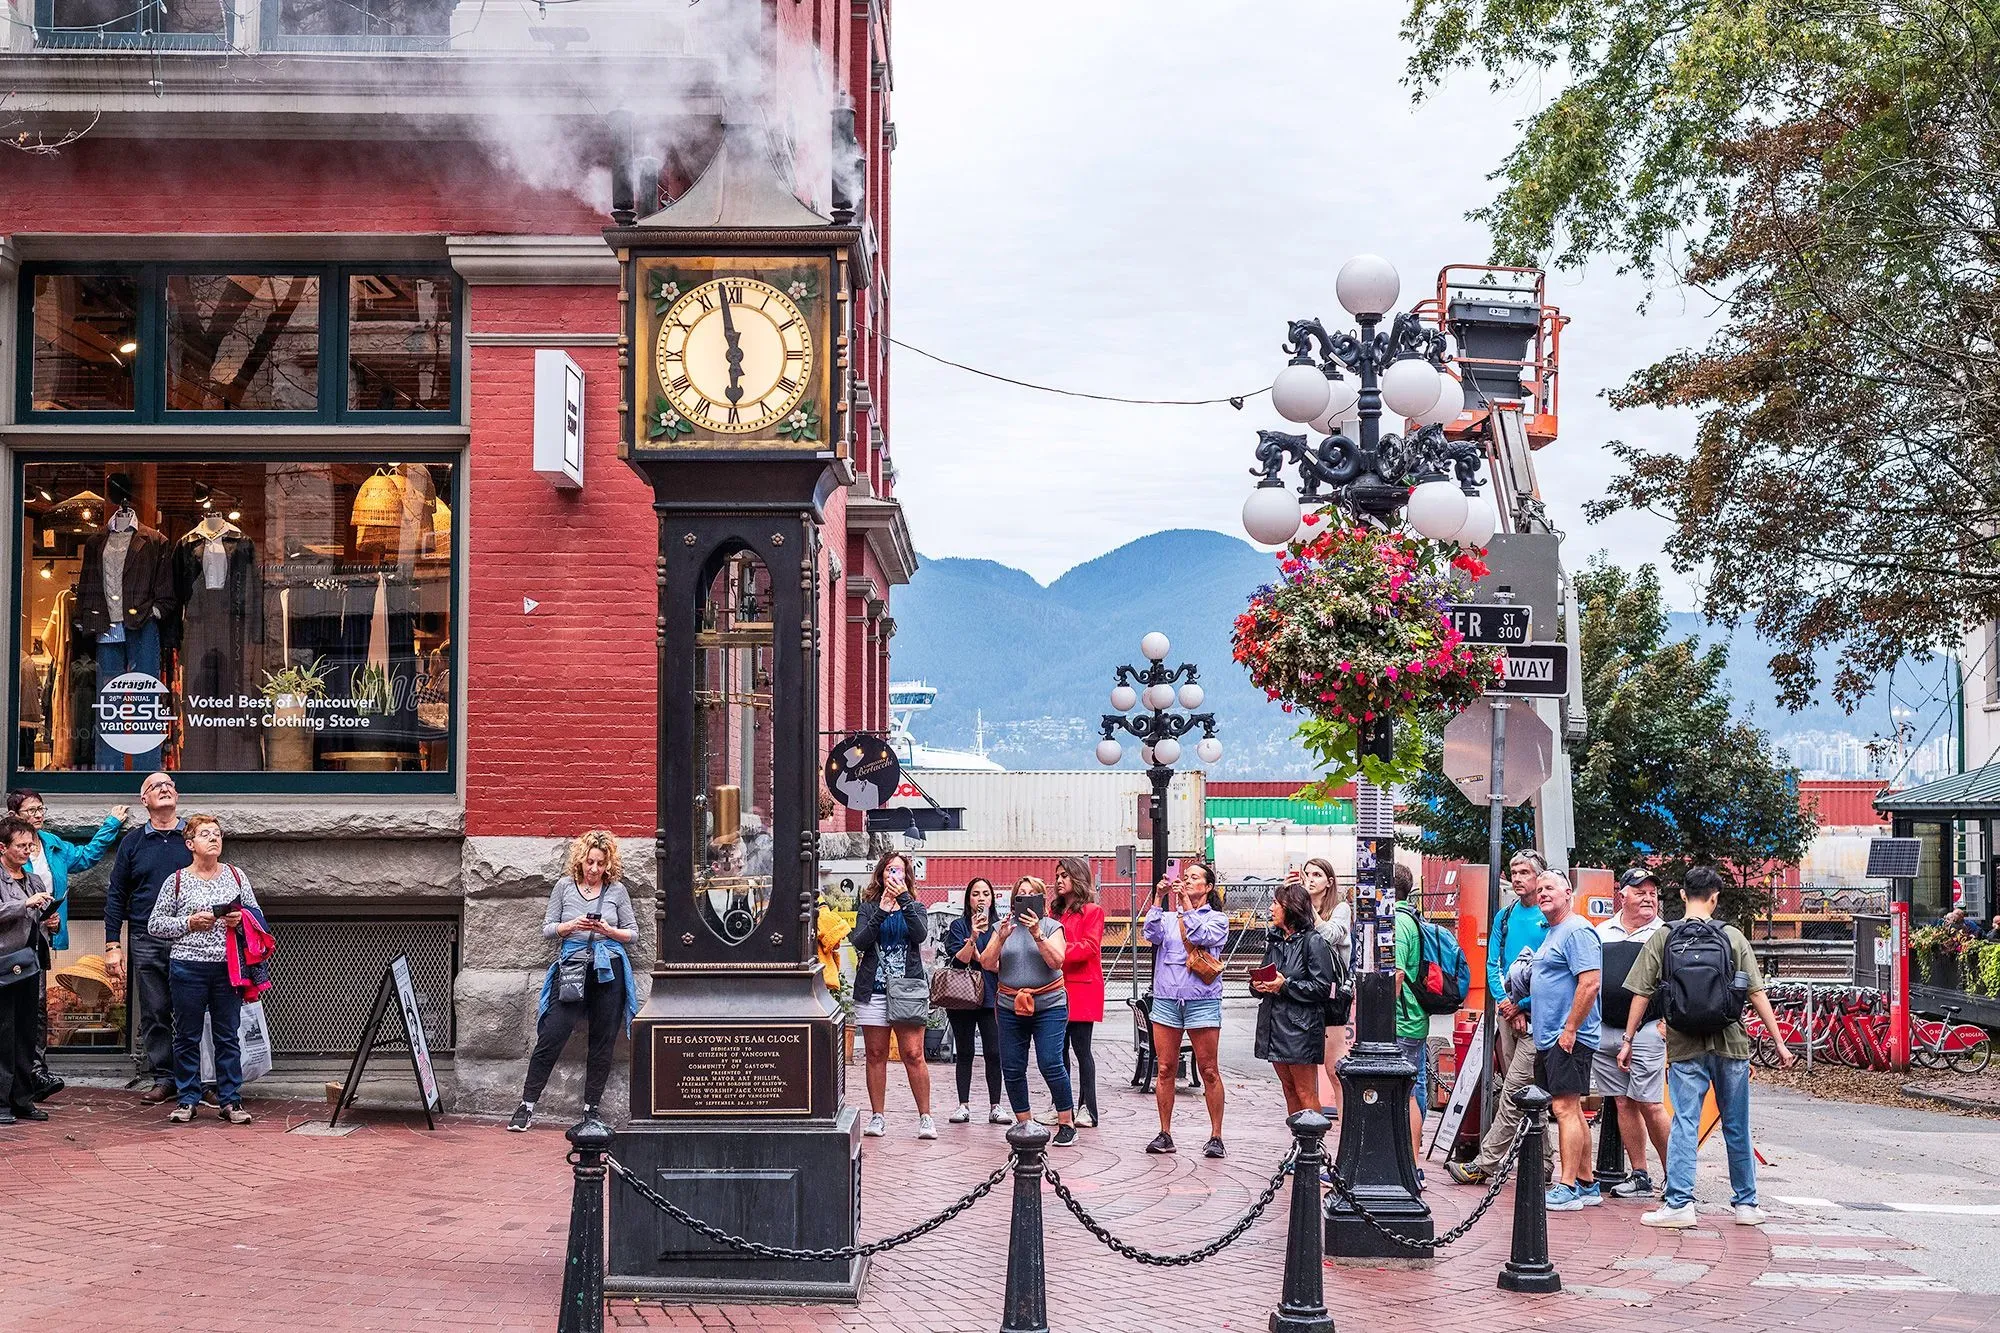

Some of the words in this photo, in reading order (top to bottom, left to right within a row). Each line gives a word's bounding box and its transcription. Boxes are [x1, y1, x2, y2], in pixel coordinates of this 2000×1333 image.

[1503, 613, 1515, 626] ST
[1498, 626, 1521, 639] 300
[1509, 660, 1550, 678] WAY
[110, 680, 157, 690] straight
[187, 694, 233, 708] Voted
[238, 694, 272, 708] Best
[276, 693, 292, 708] of
[297, 694, 375, 708] Vancouver
[91, 695, 178, 721] best
[160, 707, 171, 716] of
[100, 722, 169, 731] vancouver
[187, 714, 257, 728] Women's
[261, 713, 325, 731] Clothing
[329, 714, 370, 728] Store
[663, 1035, 682, 1044] THE
[684, 1035, 732, 1044] GASTOWN
[734, 1035, 765, 1043] STEAM
[767, 1034, 800, 1043] CLOCK
